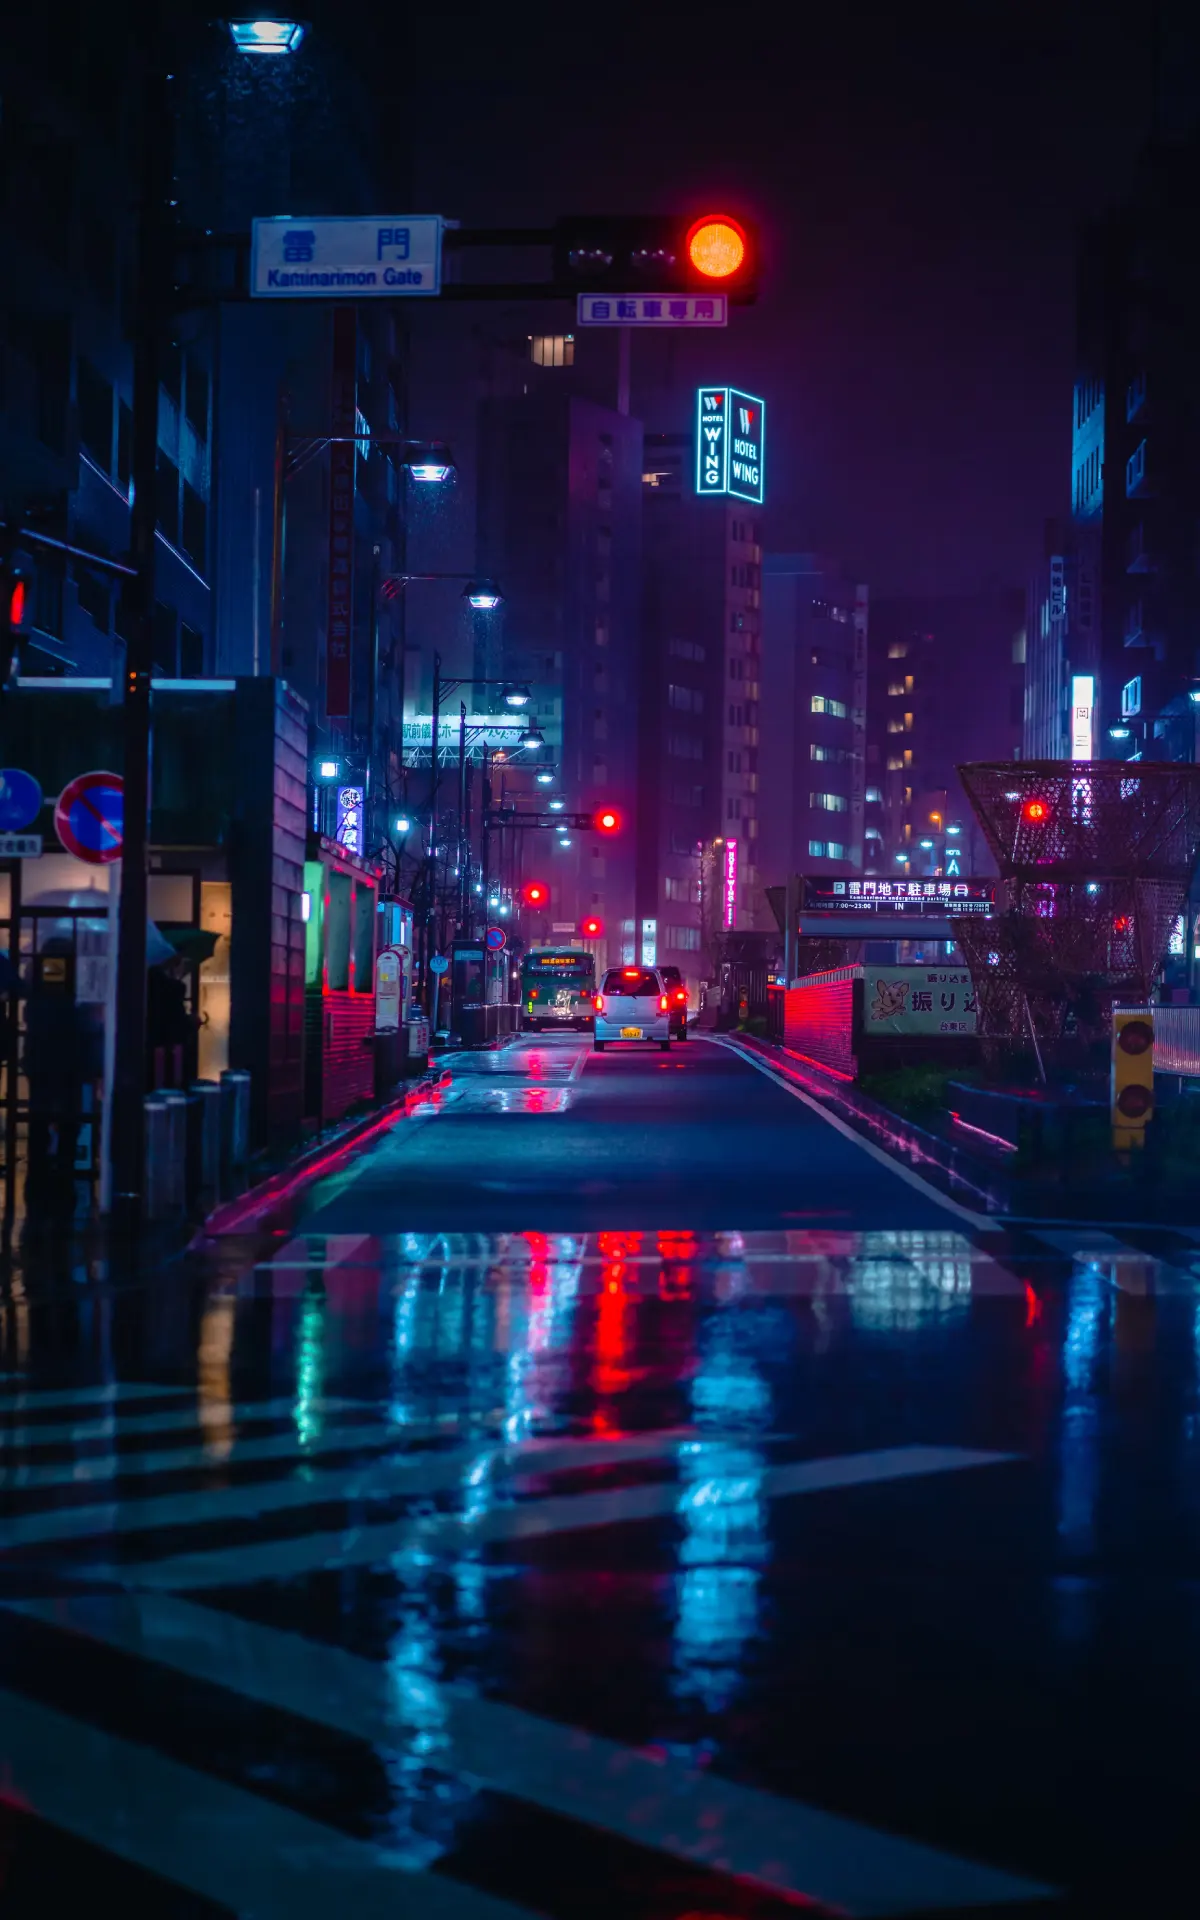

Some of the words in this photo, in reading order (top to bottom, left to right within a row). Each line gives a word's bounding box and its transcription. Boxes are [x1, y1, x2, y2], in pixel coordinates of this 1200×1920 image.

[268, 269, 376, 286] Kaminarimon
[383, 268, 422, 285] Gate
[704, 427, 721, 484] WING
[734, 438, 757, 460] HOTEL
[732, 459, 759, 485] WING
[849, 881, 951, 897] 雷門地下駐車場
[894, 902, 904, 911] IN
[940, 1021, 967, 1032] 台東区
